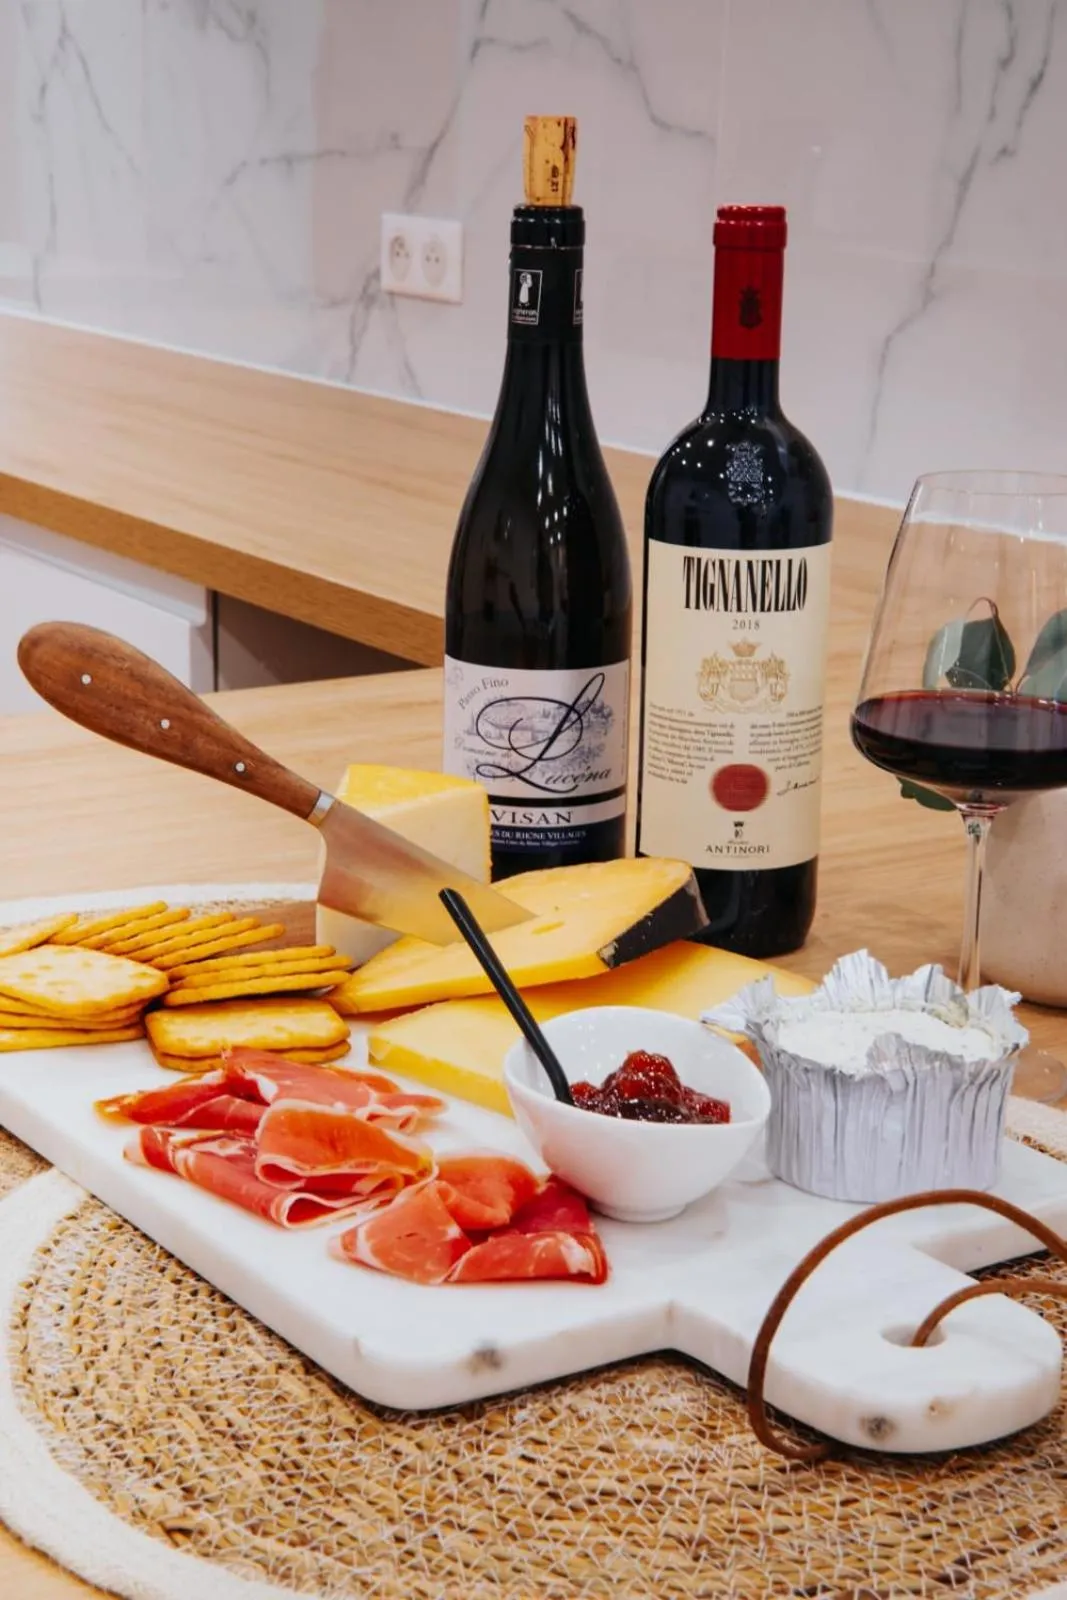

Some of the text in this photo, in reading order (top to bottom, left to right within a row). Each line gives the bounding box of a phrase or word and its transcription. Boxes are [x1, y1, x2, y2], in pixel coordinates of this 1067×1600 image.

[683, 556, 808, 613] TIGNANELLO
[732, 619, 760, 630] 2018
[482, 677, 509, 690] Fino
[491, 810, 573, 825] VISAN
[501, 830, 514, 839] DU
[547, 830, 587, 840] VILLAGES
[705, 845, 771, 854] ANTINORI
